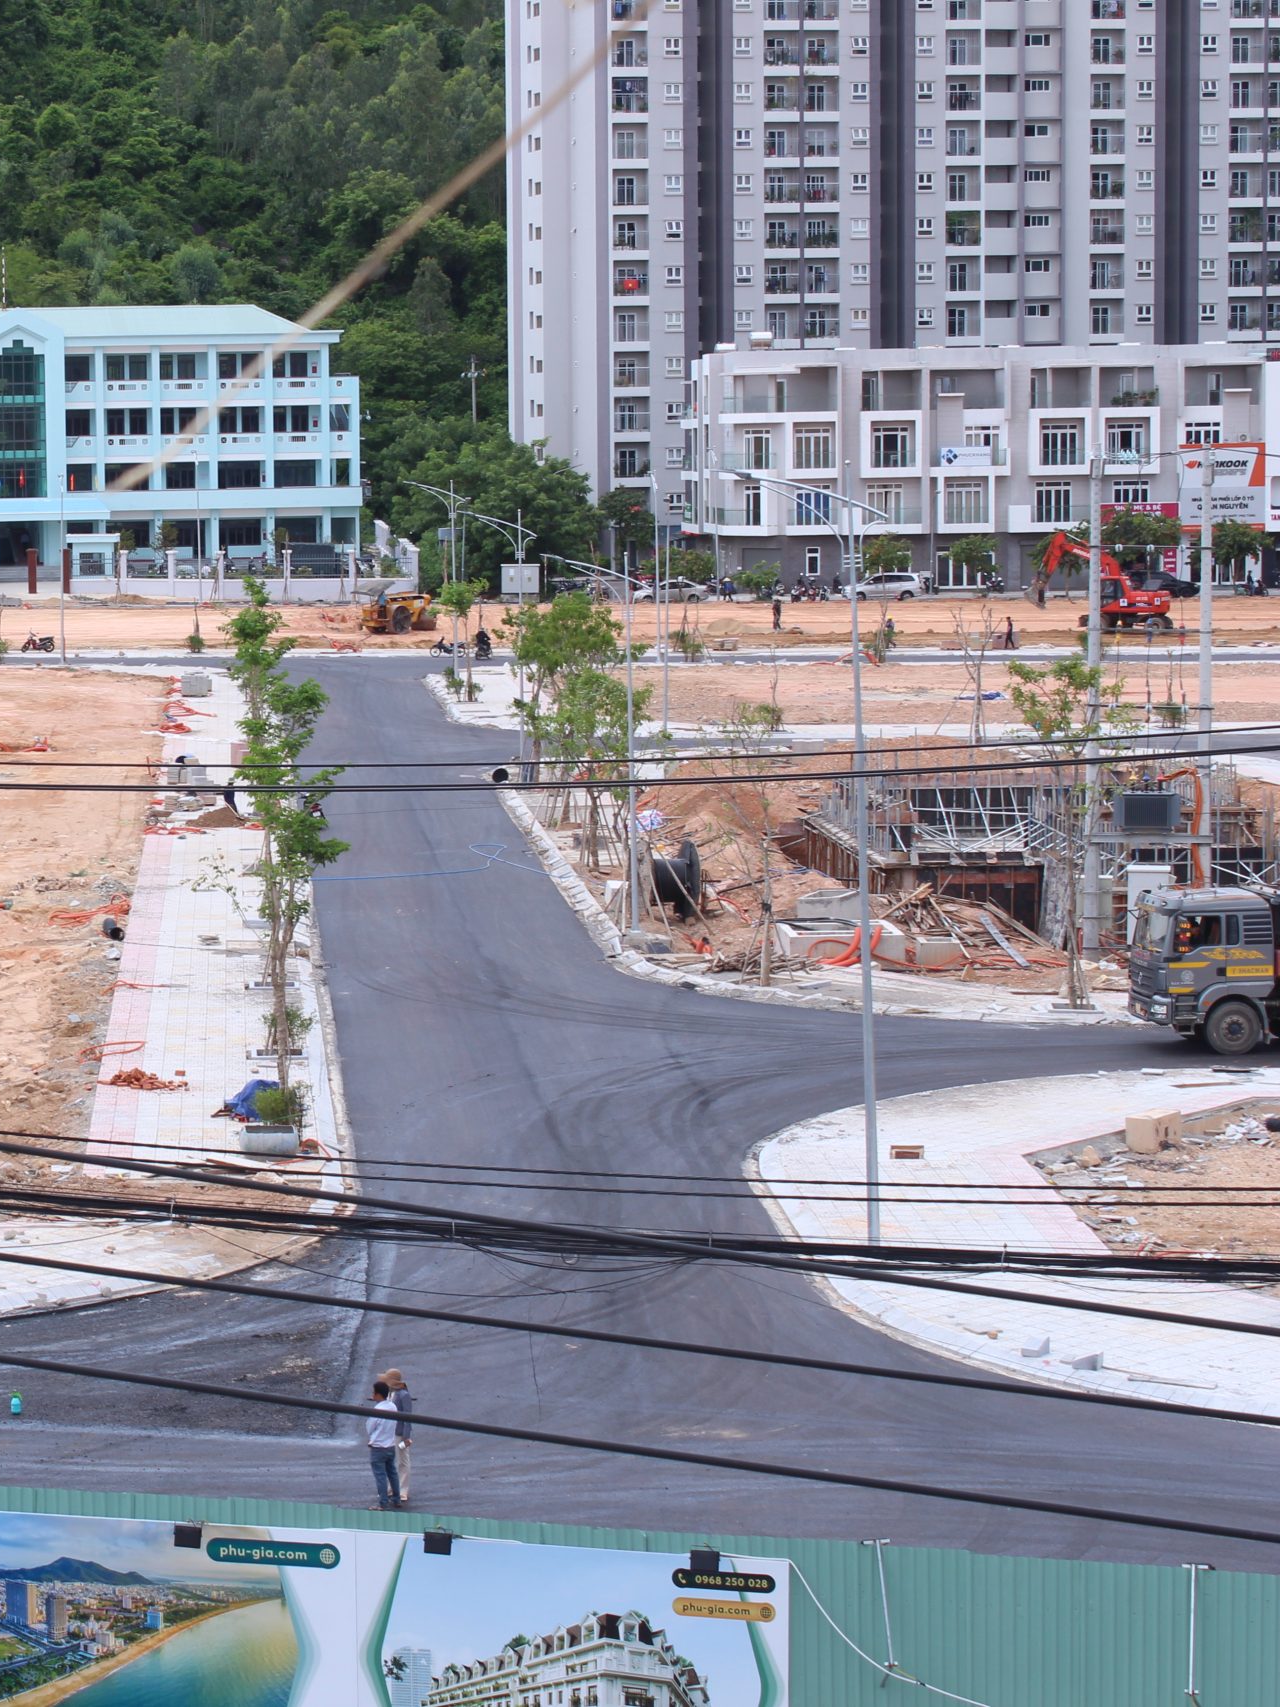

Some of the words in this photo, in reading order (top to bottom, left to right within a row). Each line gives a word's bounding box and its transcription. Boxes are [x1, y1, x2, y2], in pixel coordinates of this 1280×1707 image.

[220, 1544, 308, 1560] phu-gia.com
[694, 1574, 722, 1585] 0968
[725, 1577, 744, 1587] 250
[748, 1578, 768, 1588] 028
[682, 1602, 751, 1615] phu-gia.com
